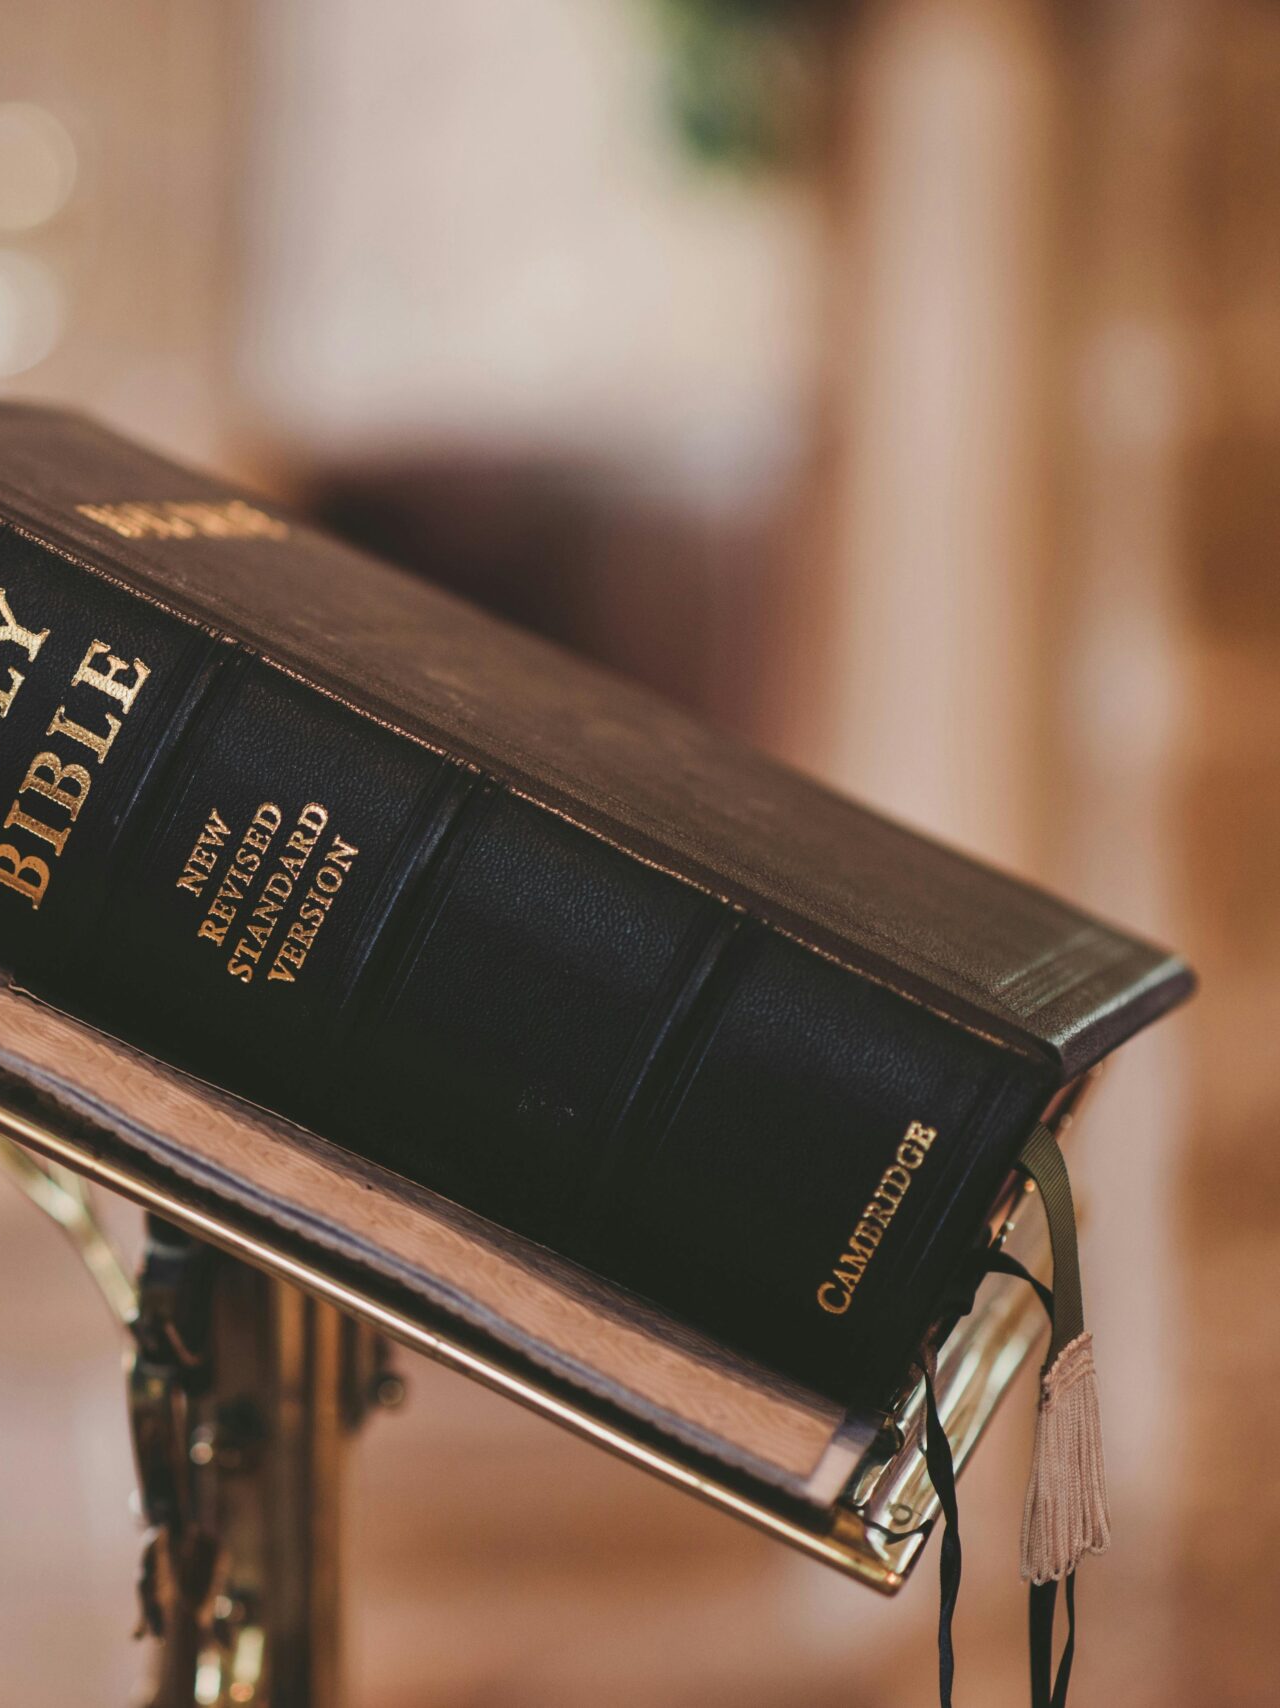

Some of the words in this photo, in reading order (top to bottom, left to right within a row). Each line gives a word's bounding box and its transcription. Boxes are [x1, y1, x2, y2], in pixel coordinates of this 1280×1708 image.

[175, 807, 232, 898] NEW
[197, 801, 282, 947] REVISED
[226, 801, 329, 984] STANDARD
[267, 833, 360, 983] VERSION
[816, 1119, 938, 1314] CAMBRIDGE
